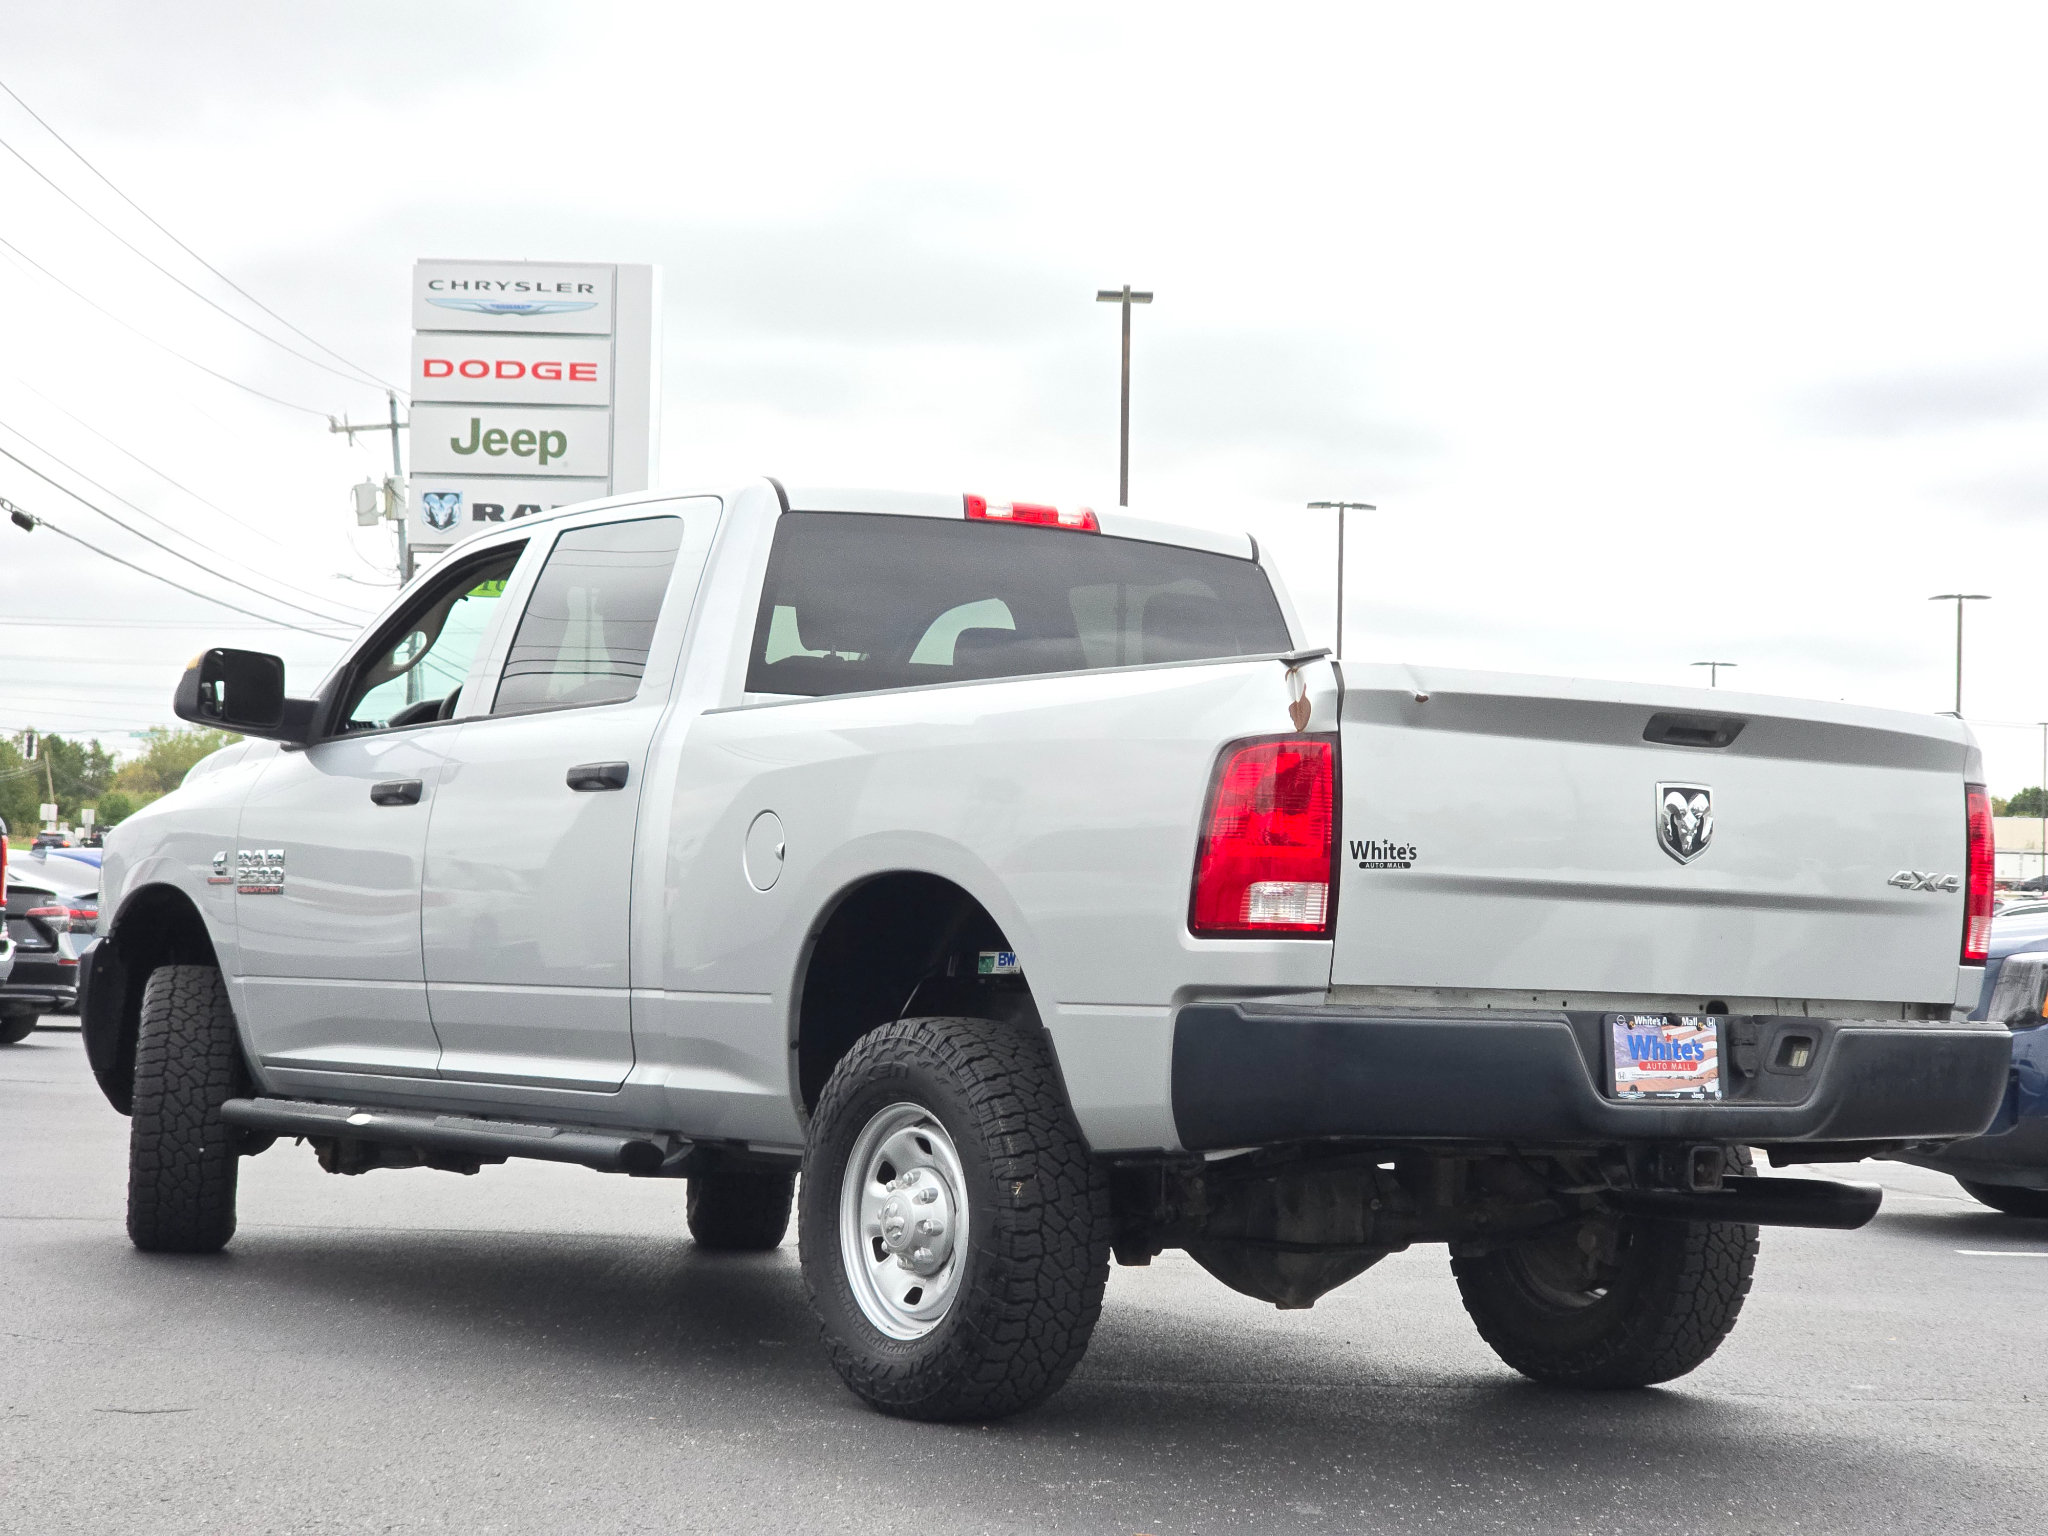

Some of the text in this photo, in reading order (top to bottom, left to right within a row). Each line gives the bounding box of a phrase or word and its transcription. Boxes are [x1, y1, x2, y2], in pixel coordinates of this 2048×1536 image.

[428, 279, 595, 295] CHRYSLER
[423, 359, 598, 382] DODGE
[450, 417, 568, 466] Jeep
[237, 849, 286, 866] RAM
[1349, 839, 1418, 861] White's
[237, 866, 284, 884] 2500
[237, 886, 279, 894] HEAVY DUTY
[1634, 1015, 1661, 1026] White's
[1681, 1016, 1698, 1026] Mall
[1626, 1033, 1705, 1061] White's
[1646, 1062, 1691, 1070] AUTO MALL
